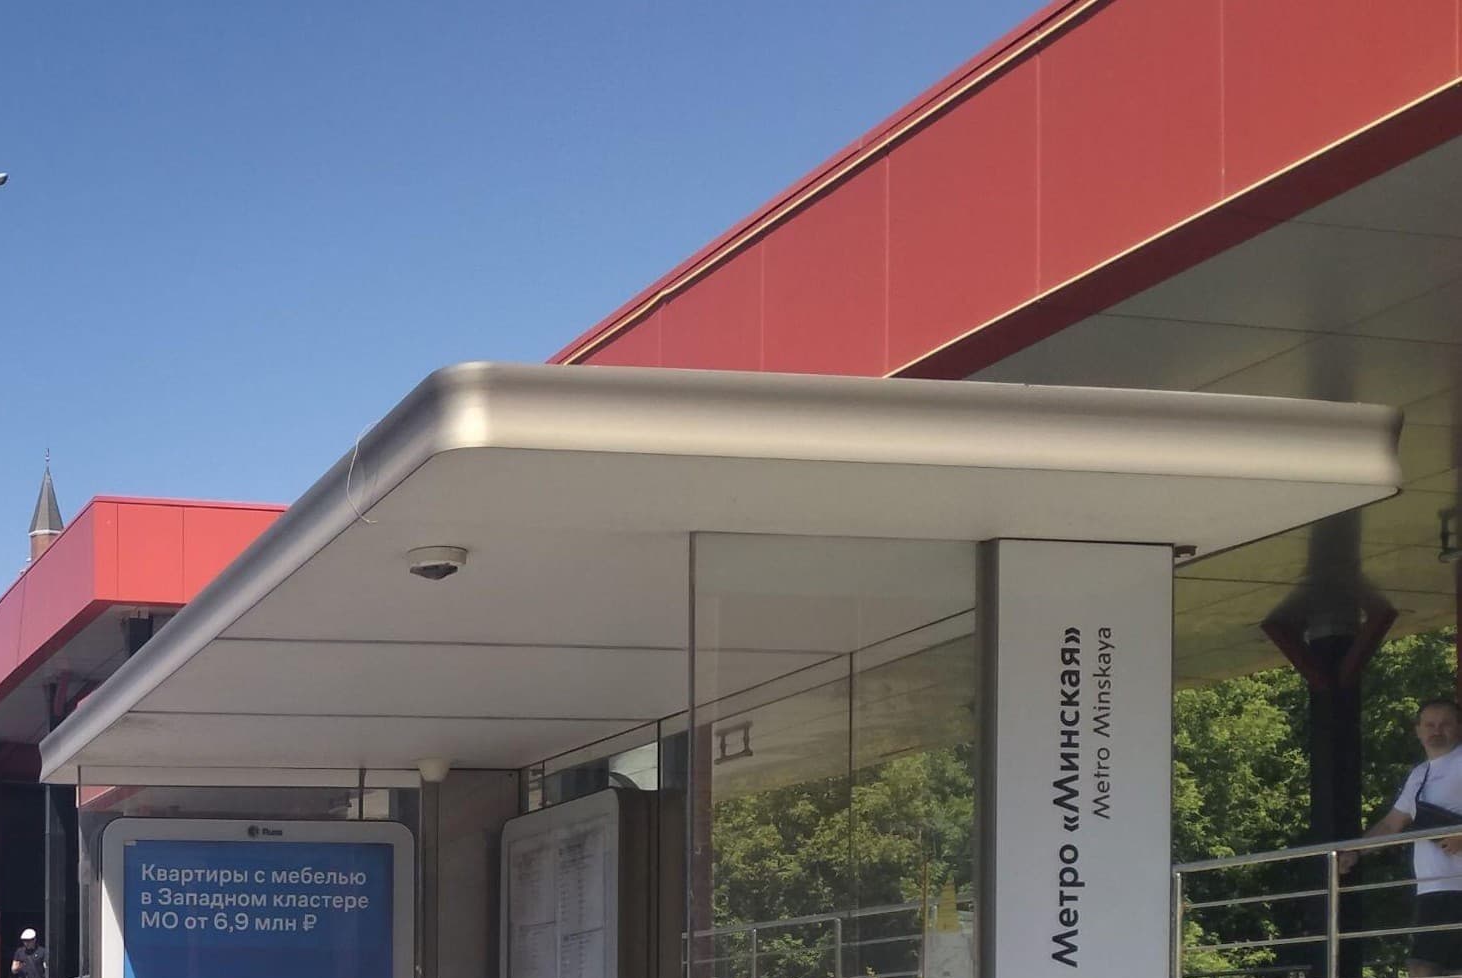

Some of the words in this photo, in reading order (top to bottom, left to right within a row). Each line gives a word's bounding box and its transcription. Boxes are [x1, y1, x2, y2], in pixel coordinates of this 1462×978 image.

[1092, 627, 1116, 737] Minskaya
[1052, 626, 1081, 833] «Минская»
[1093, 747, 1111, 819] Metro
[141, 863, 248, 885] Квартиры
[254, 869, 265, 883] с
[271, 867, 367, 885] мебелью
[141, 892, 152, 905] в
[157, 887, 267, 909] Западном
[273, 894, 369, 913] кластере
[1051, 843, 1085, 968] Метро
[141, 911, 179, 929] МО
[184, 916, 208, 930] от
[213, 913, 249, 933] 6,9
[255, 917, 297, 931] млн
